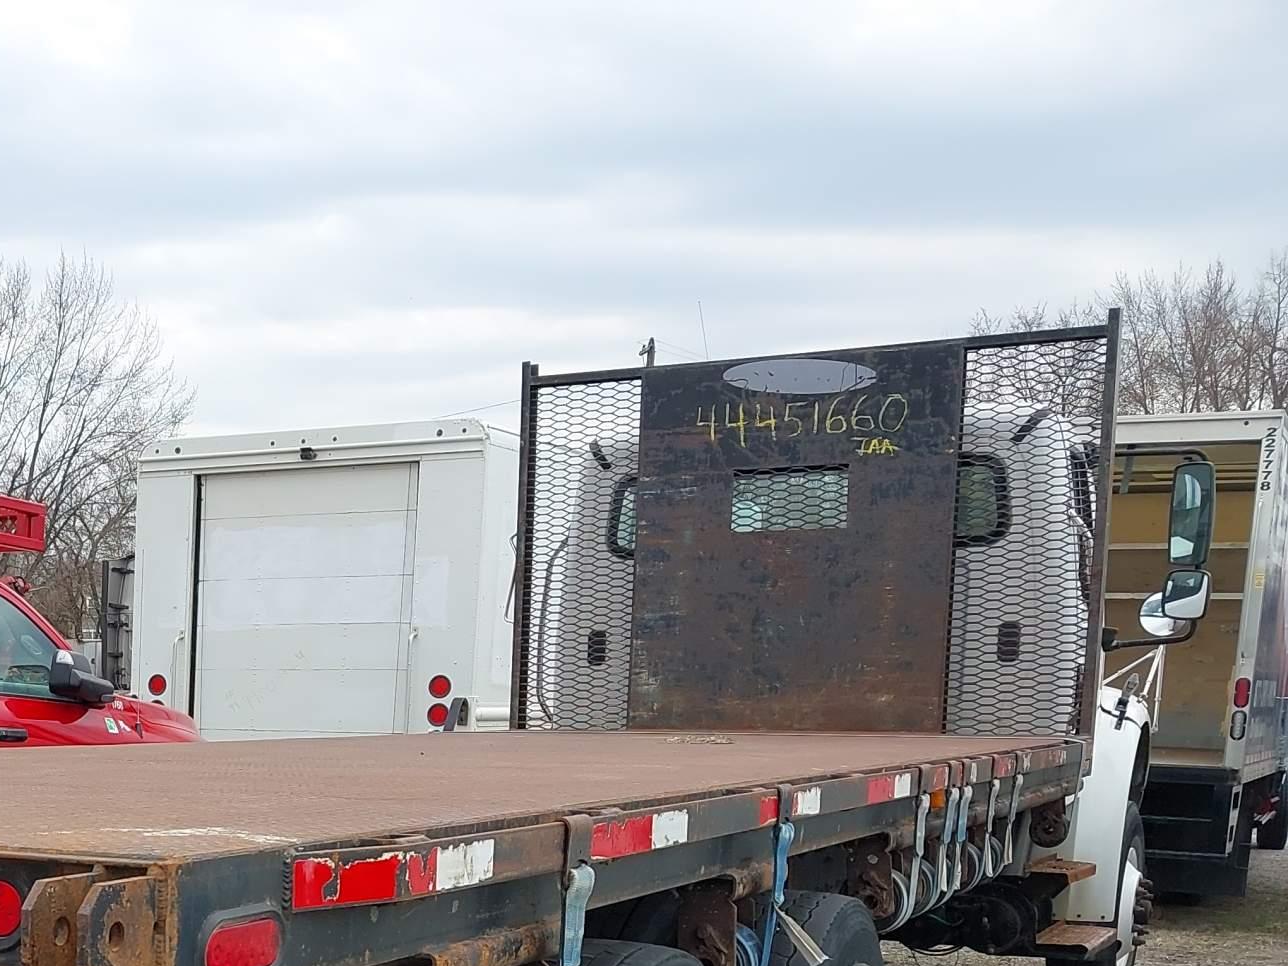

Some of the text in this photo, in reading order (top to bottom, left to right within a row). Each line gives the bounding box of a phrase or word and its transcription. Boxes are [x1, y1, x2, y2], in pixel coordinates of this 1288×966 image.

[696, 394, 908, 448] 44451660
[850, 436, 903, 456] IAA
[1260, 427, 1277, 491] 227778
